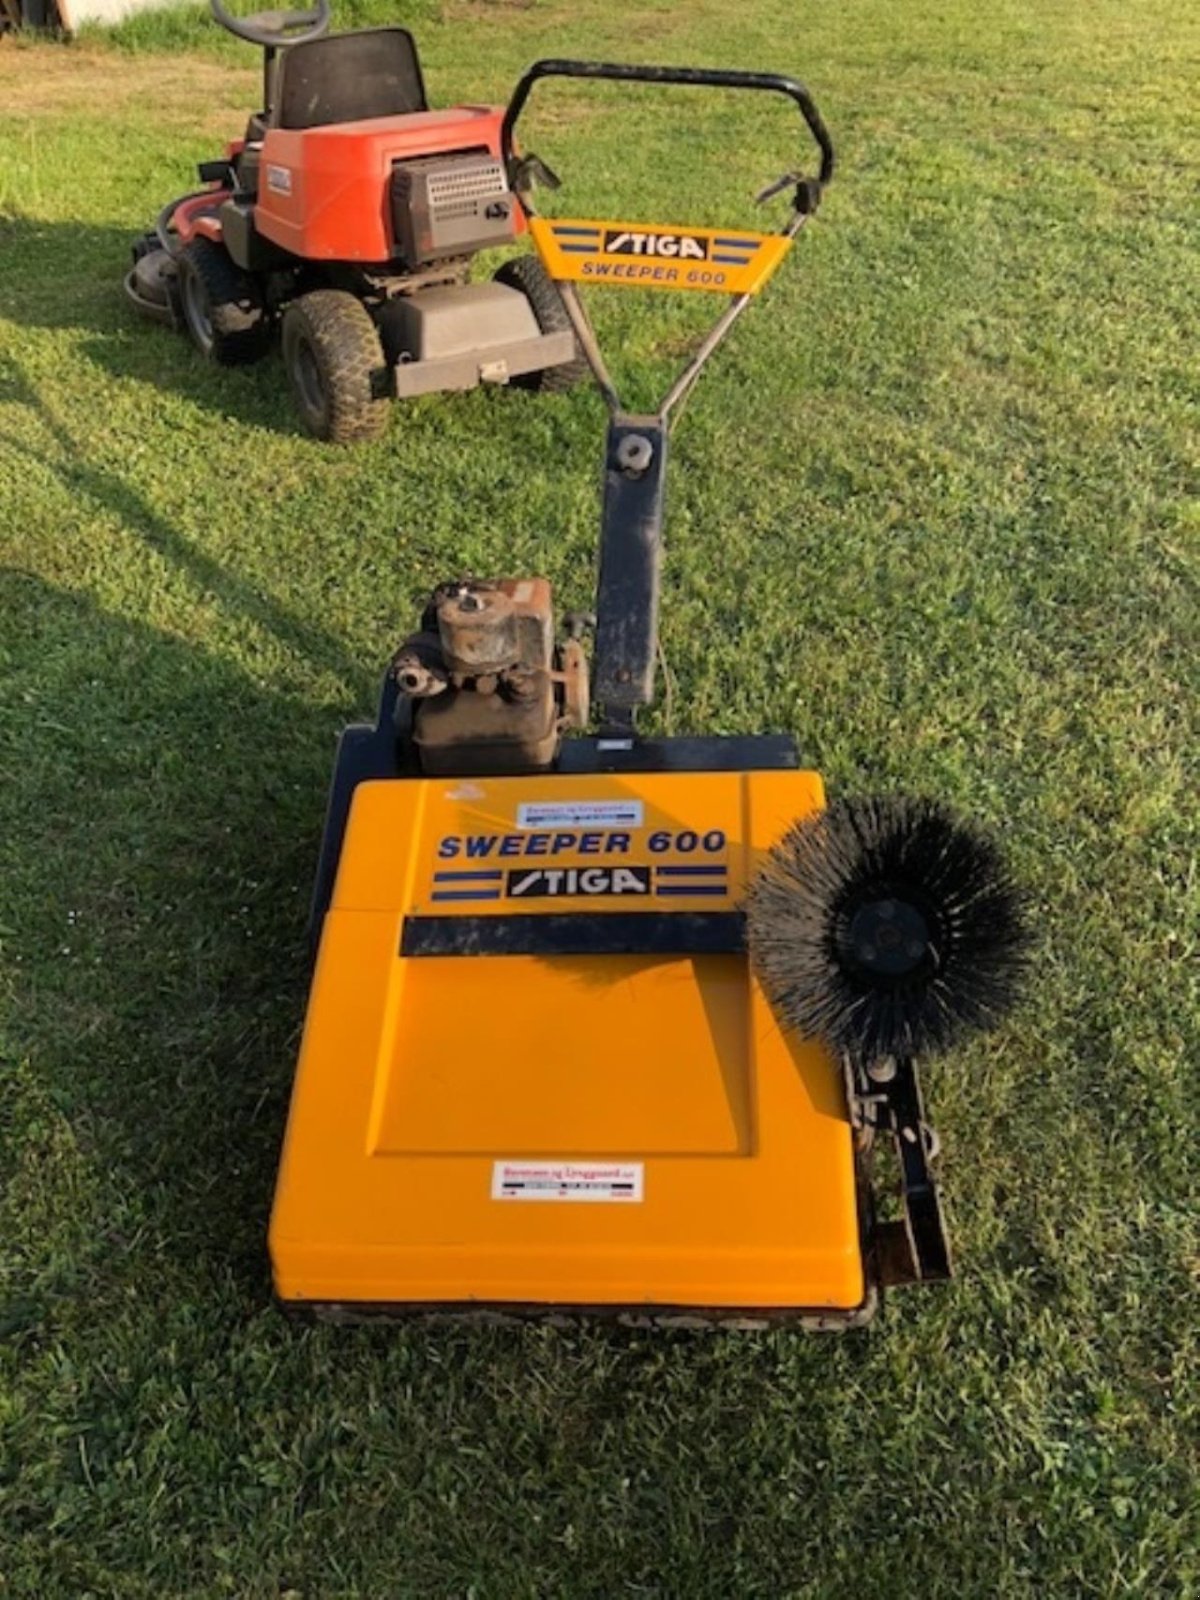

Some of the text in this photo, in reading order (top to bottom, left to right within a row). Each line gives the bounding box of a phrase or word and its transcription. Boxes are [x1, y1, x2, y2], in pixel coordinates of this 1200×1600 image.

[606, 233, 705, 258] STIGA
[582, 261, 726, 285] SWEEPER 600
[438, 830, 726, 858] SWEEPER 600
[511, 867, 646, 896] STIGA
